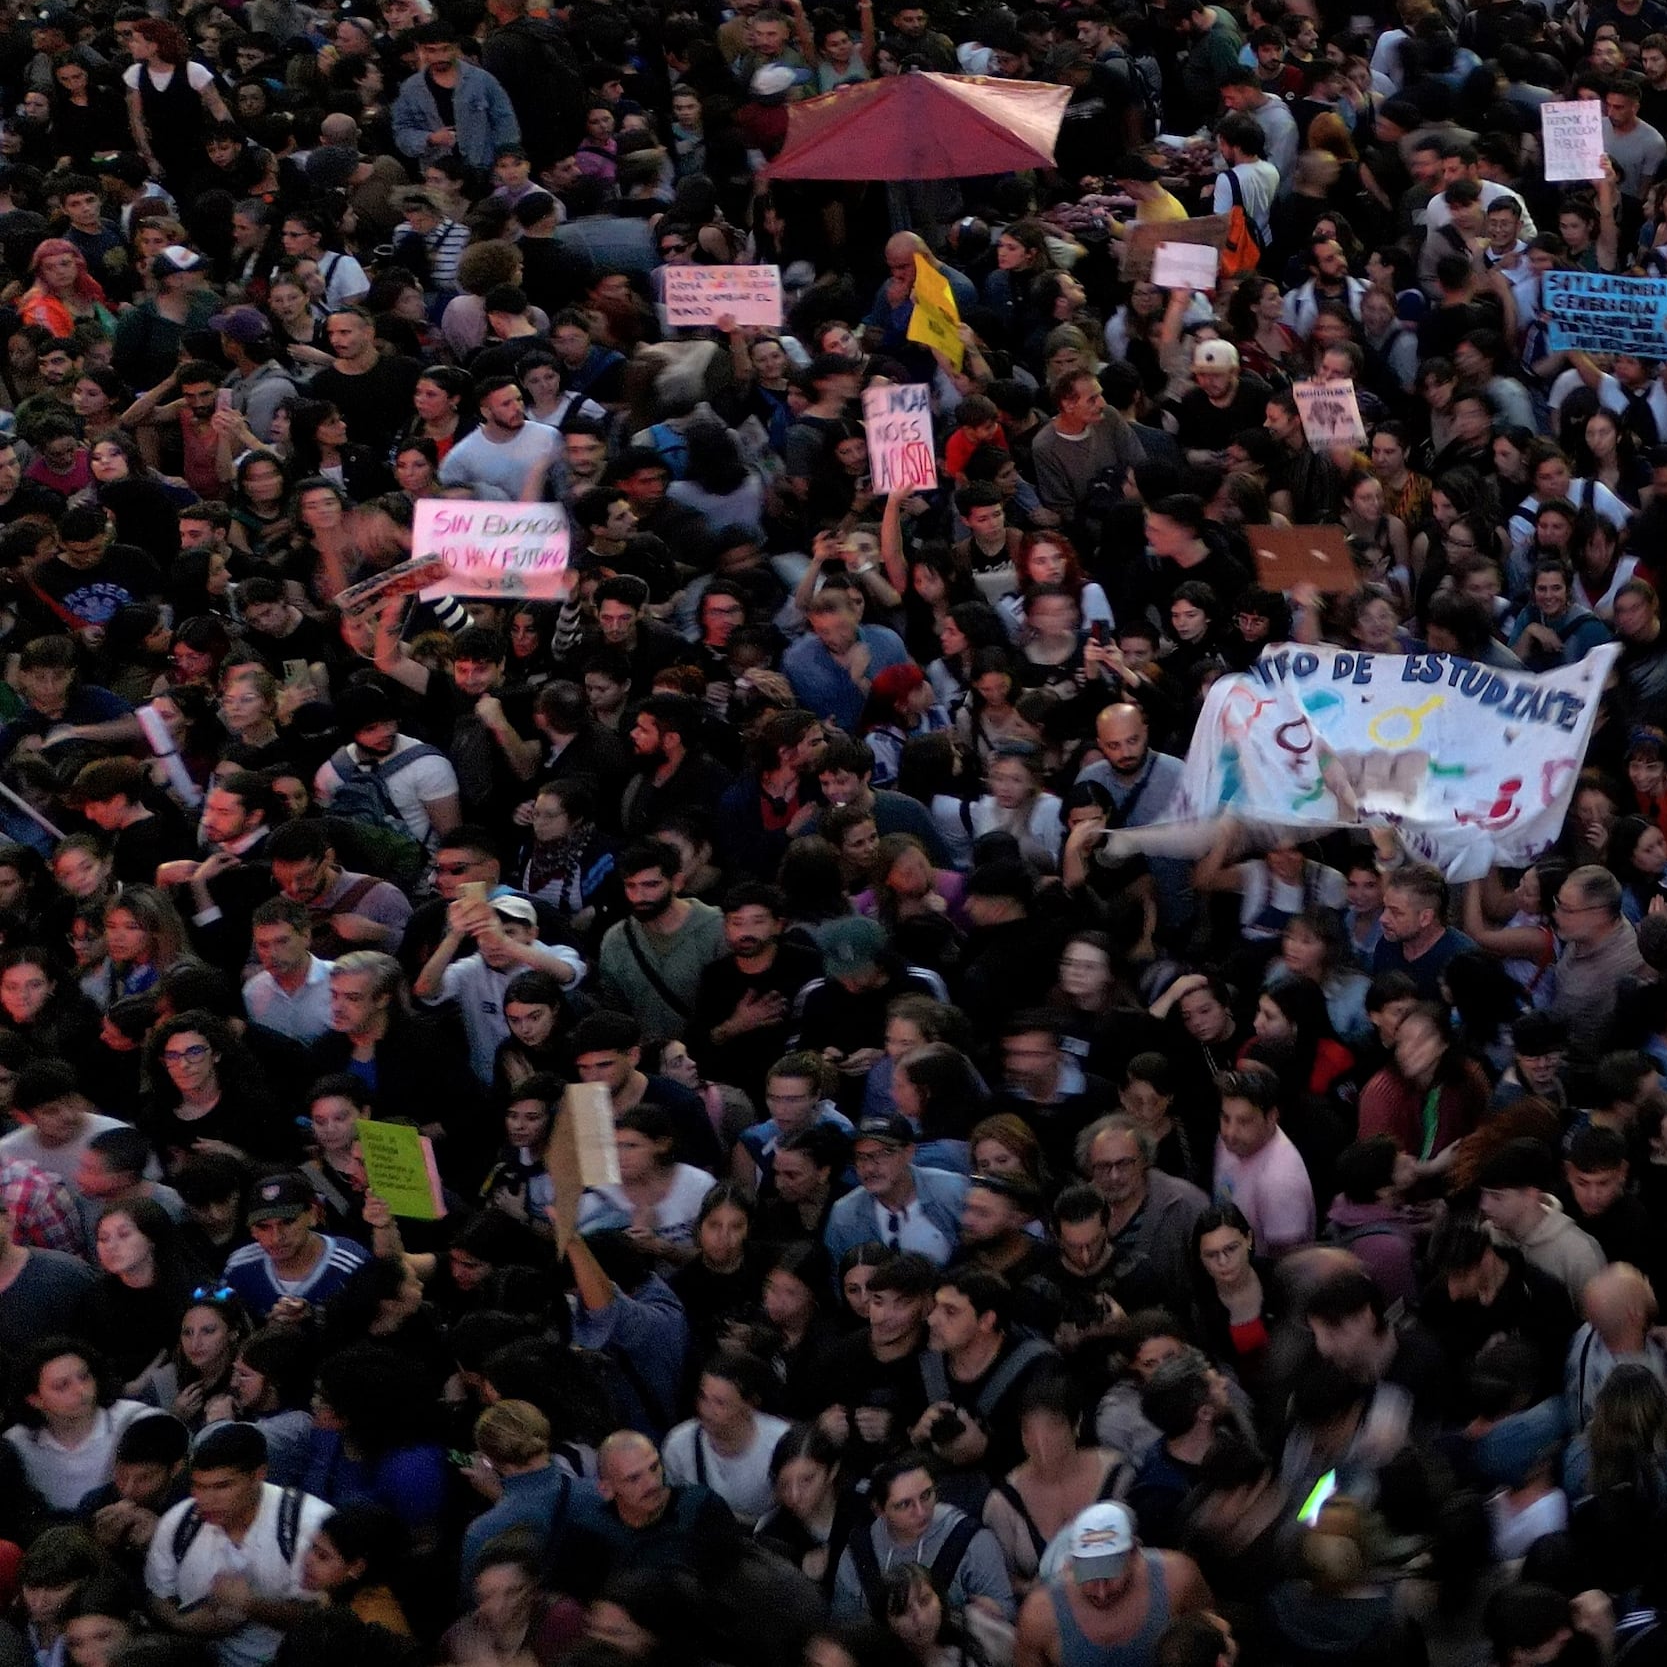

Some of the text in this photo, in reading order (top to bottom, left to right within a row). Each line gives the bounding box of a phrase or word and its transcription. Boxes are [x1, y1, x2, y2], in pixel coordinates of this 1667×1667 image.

[1587, 277, 1609, 294] LA
[432, 510, 475, 537] SIN
[441, 544, 565, 571] O HAY FUTURO
[1332, 653, 1374, 684] DE
